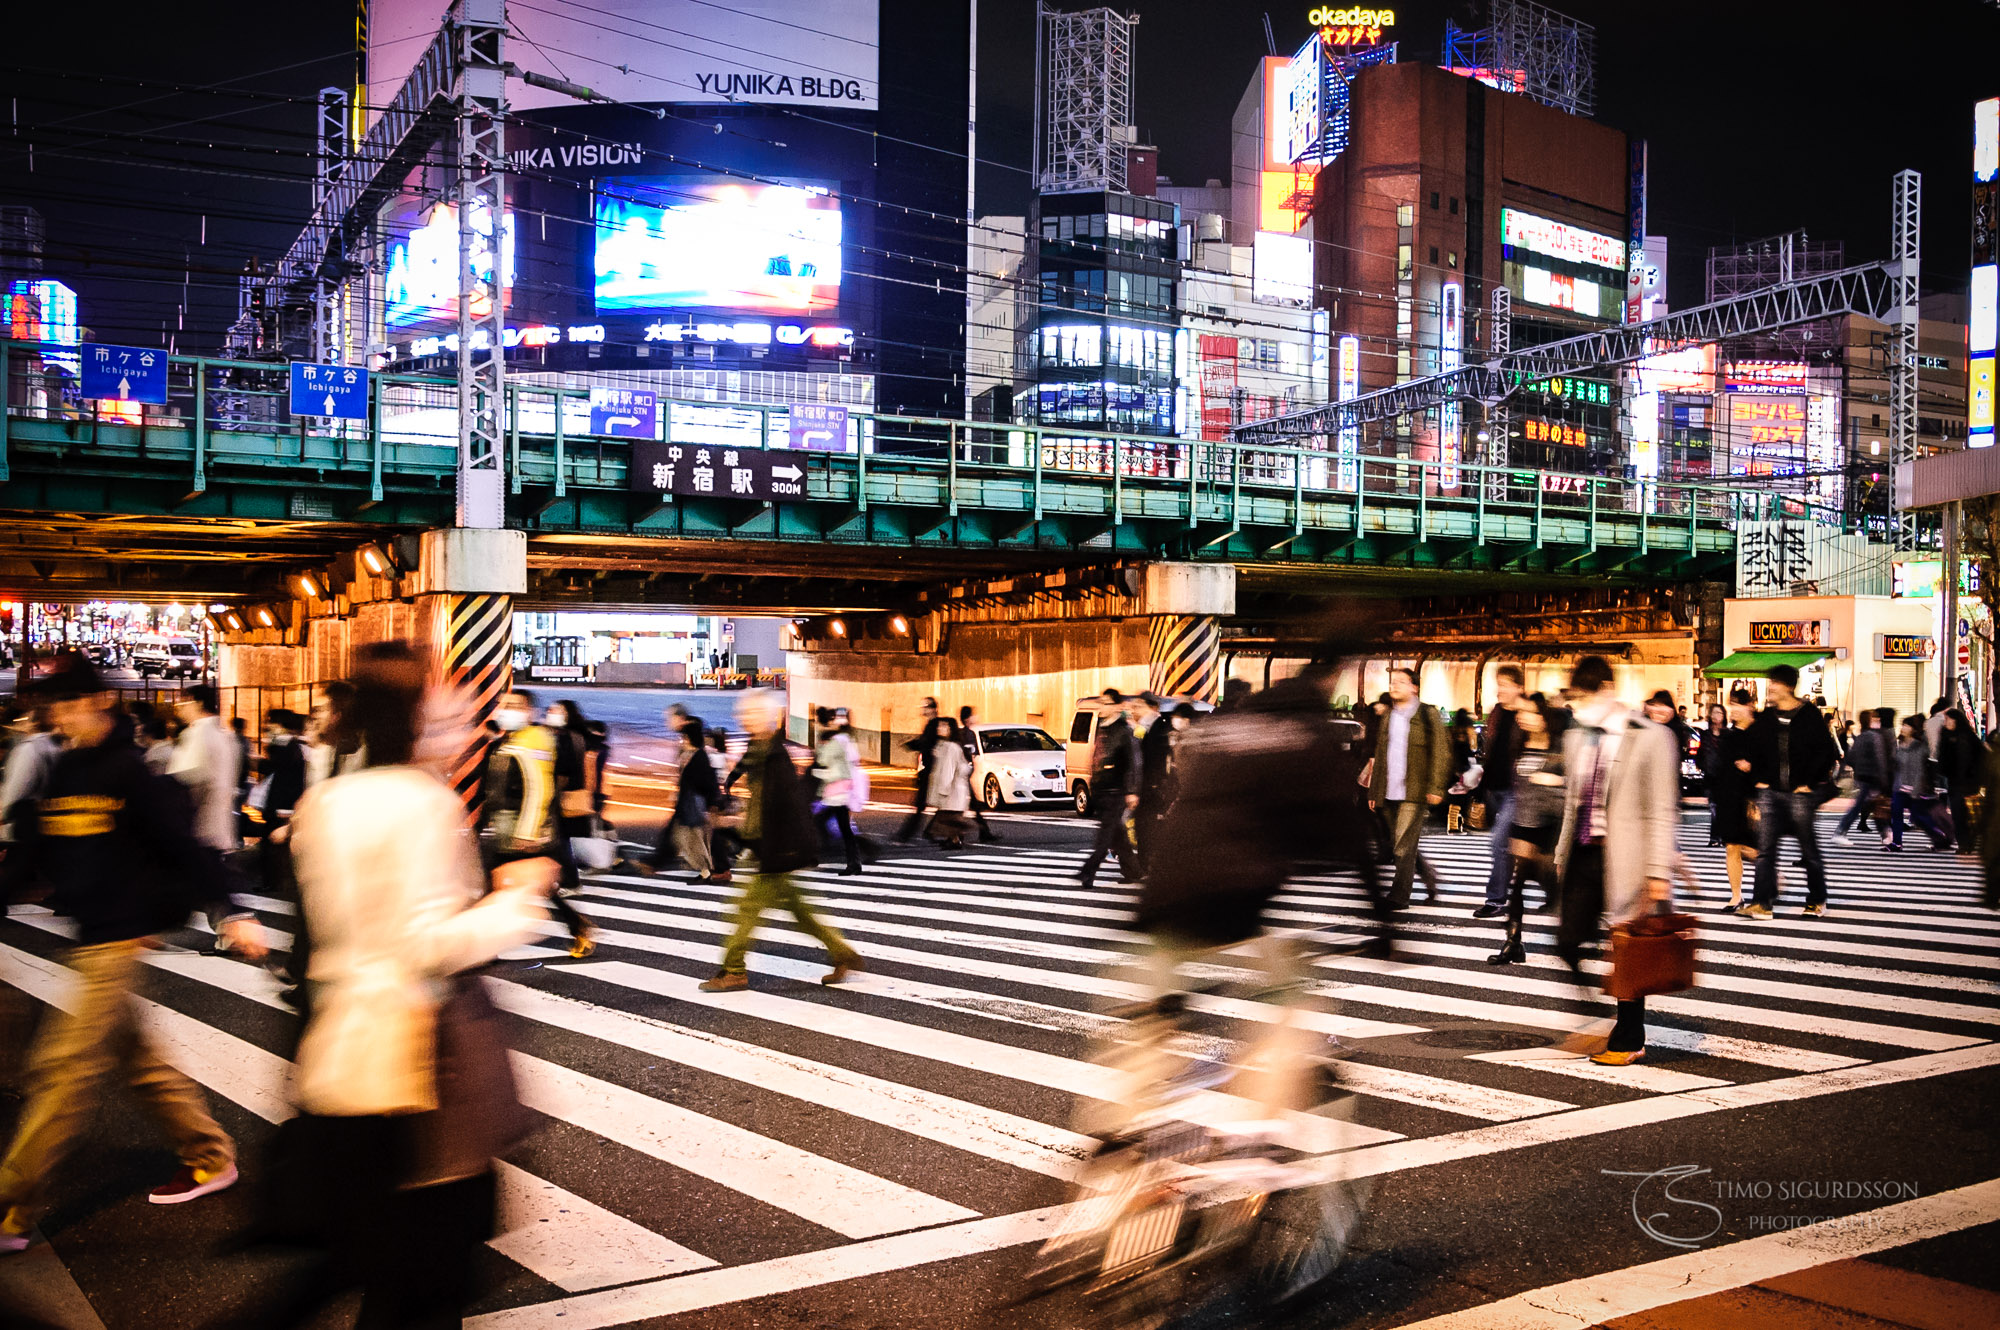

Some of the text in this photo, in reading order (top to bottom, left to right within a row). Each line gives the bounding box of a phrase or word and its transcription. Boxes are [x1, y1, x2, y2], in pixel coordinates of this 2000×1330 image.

[1308, 6, 1395, 29] okadaya
[1319, 25, 1381, 45] オカダヤ
[696, 73, 865, 101] YUNIKA BLDG.
[560, 143, 641, 167] VISION
[101, 365, 148, 378] Ichigaya
[308, 382, 351, 394] Ichigaya
[600, 405, 648, 416] Shinjuku STN
[1041, 401, 1054, 411] 5F
[1733, 403, 1804, 421] ヨドバシ
[827, 420, 840, 430] STN
[1525, 420, 1587, 448] 世界の生地
[1751, 425, 1804, 443] カメラ
[668, 446, 739, 467] 中央線
[652, 462, 754, 494] 新宿駅
[772, 481, 802, 495] 300M
[1750, 623, 1803, 644] LUCKYBOX
[1884, 636, 1926, 657] LUCKYBOX
